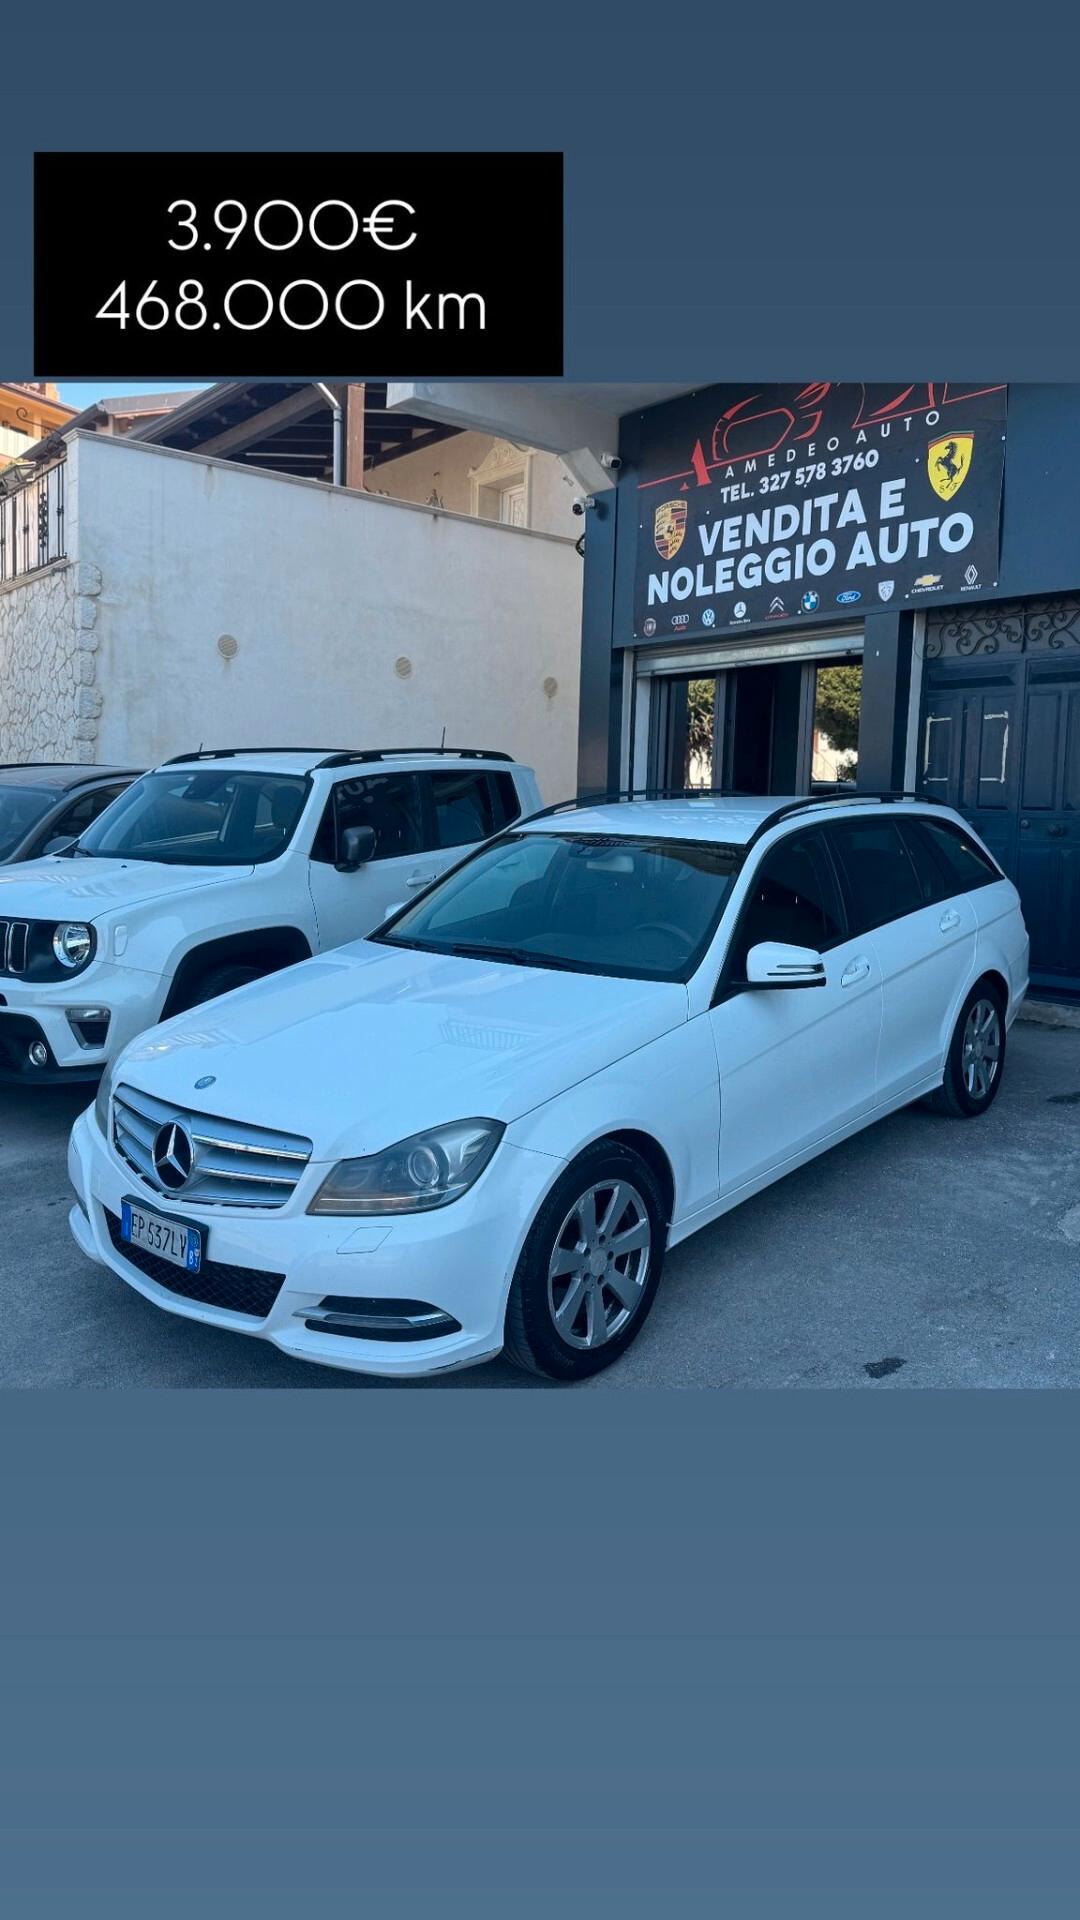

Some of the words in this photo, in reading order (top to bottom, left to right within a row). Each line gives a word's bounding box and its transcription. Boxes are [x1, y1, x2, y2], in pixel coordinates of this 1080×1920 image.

[720, 481, 755, 504] TEL.
[759, 470, 791, 495] 327
[794, 461, 827, 487] 578
[831, 449, 880, 476] 3760
[724, 437, 840, 480] AMEDEO
[855, 410, 940, 445] AUTO
[697, 488, 867, 557] VENDITA
[878, 478, 906, 520] E
[647, 538, 837, 606] NOLEGGIO
[845, 511, 975, 572] AUTO
